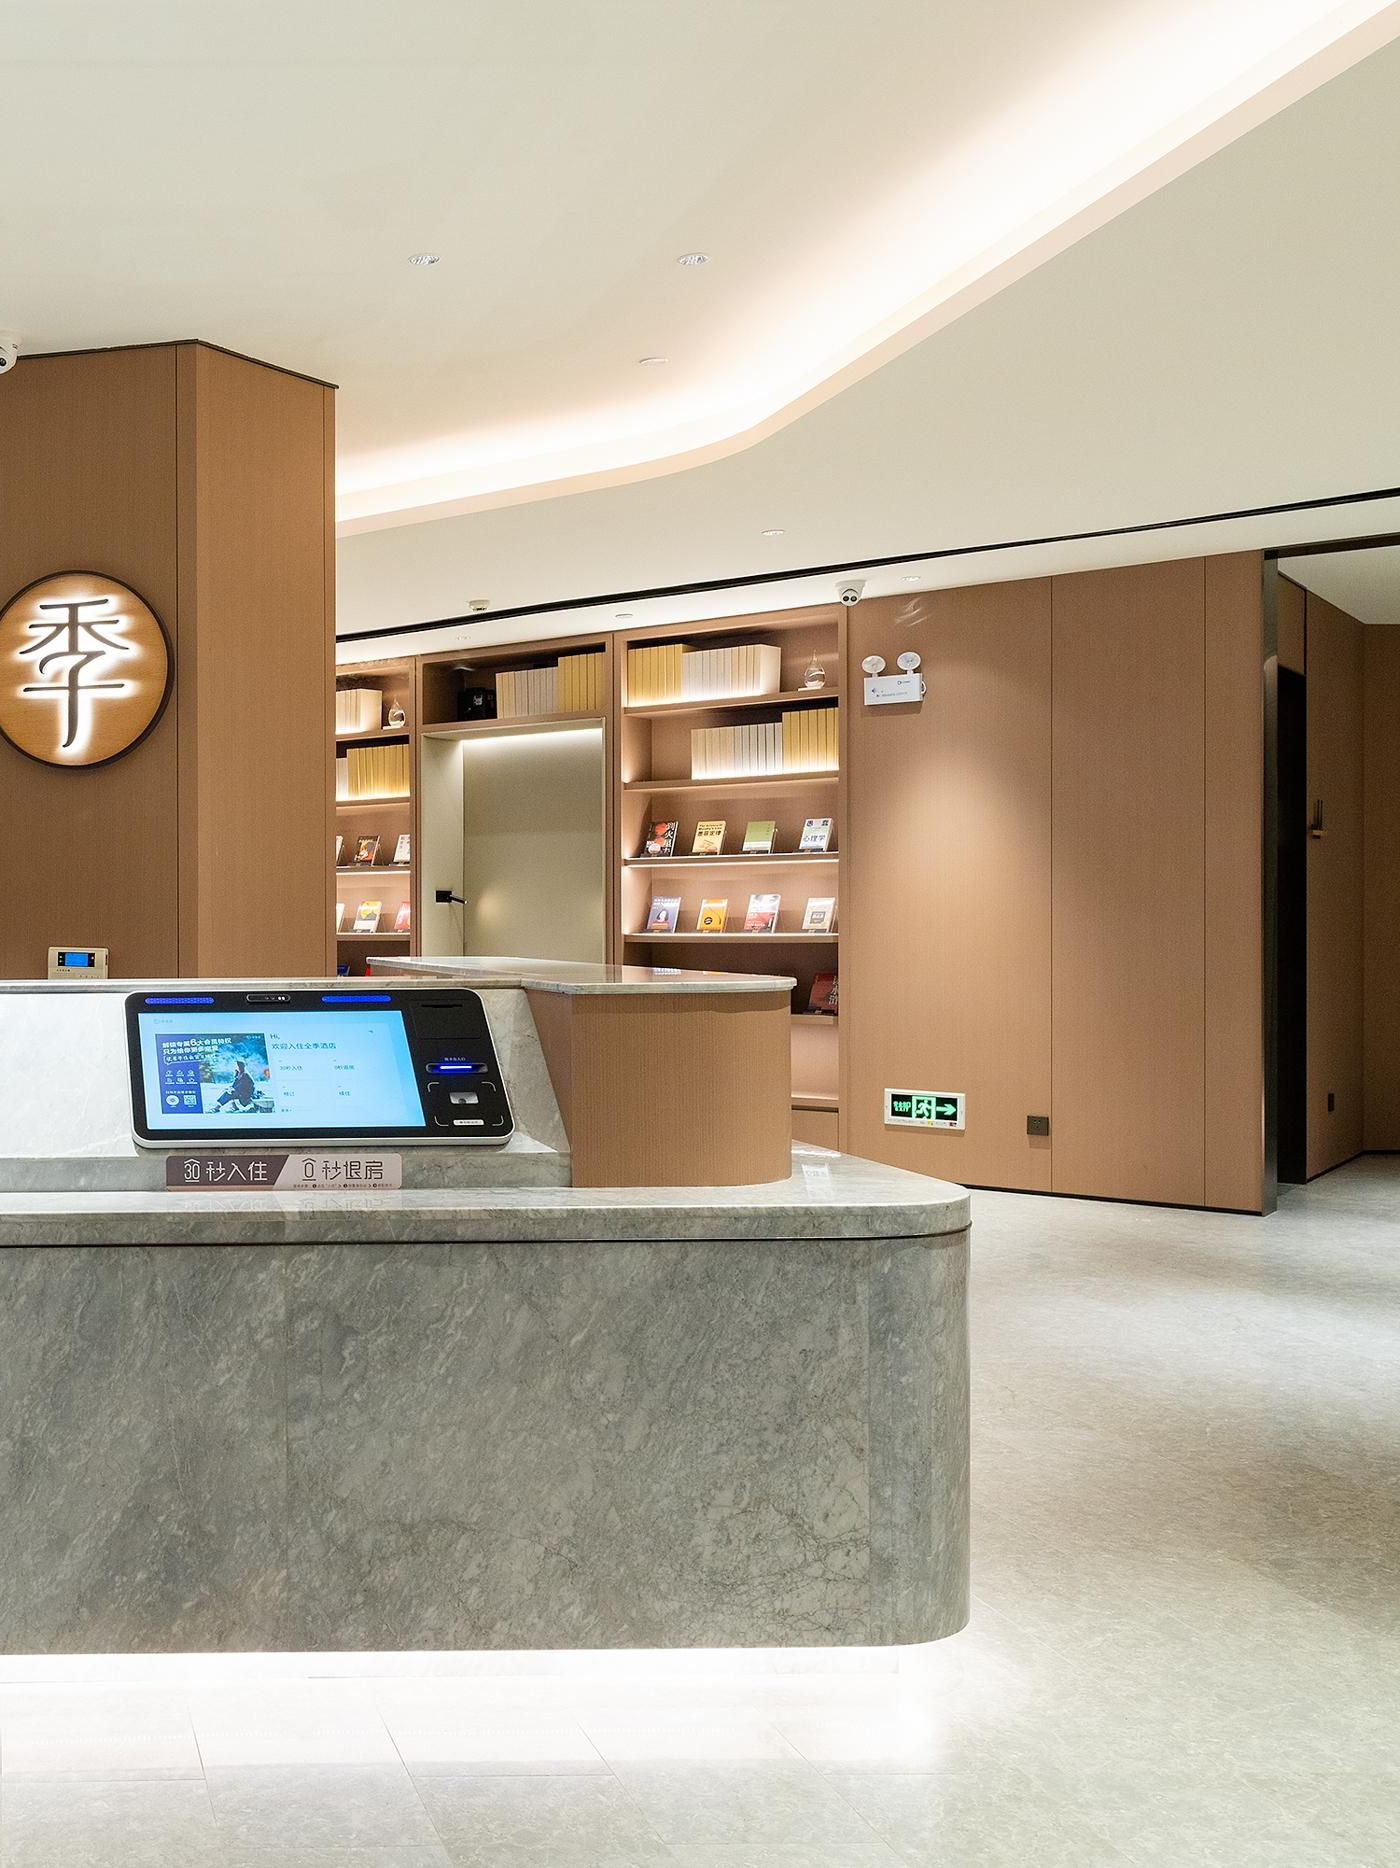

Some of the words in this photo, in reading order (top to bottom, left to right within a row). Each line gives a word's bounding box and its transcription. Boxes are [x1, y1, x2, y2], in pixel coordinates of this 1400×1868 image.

[19, 598, 130, 748] 季
[271, 1042, 336, 1050] 欢迎入住全季酒店
